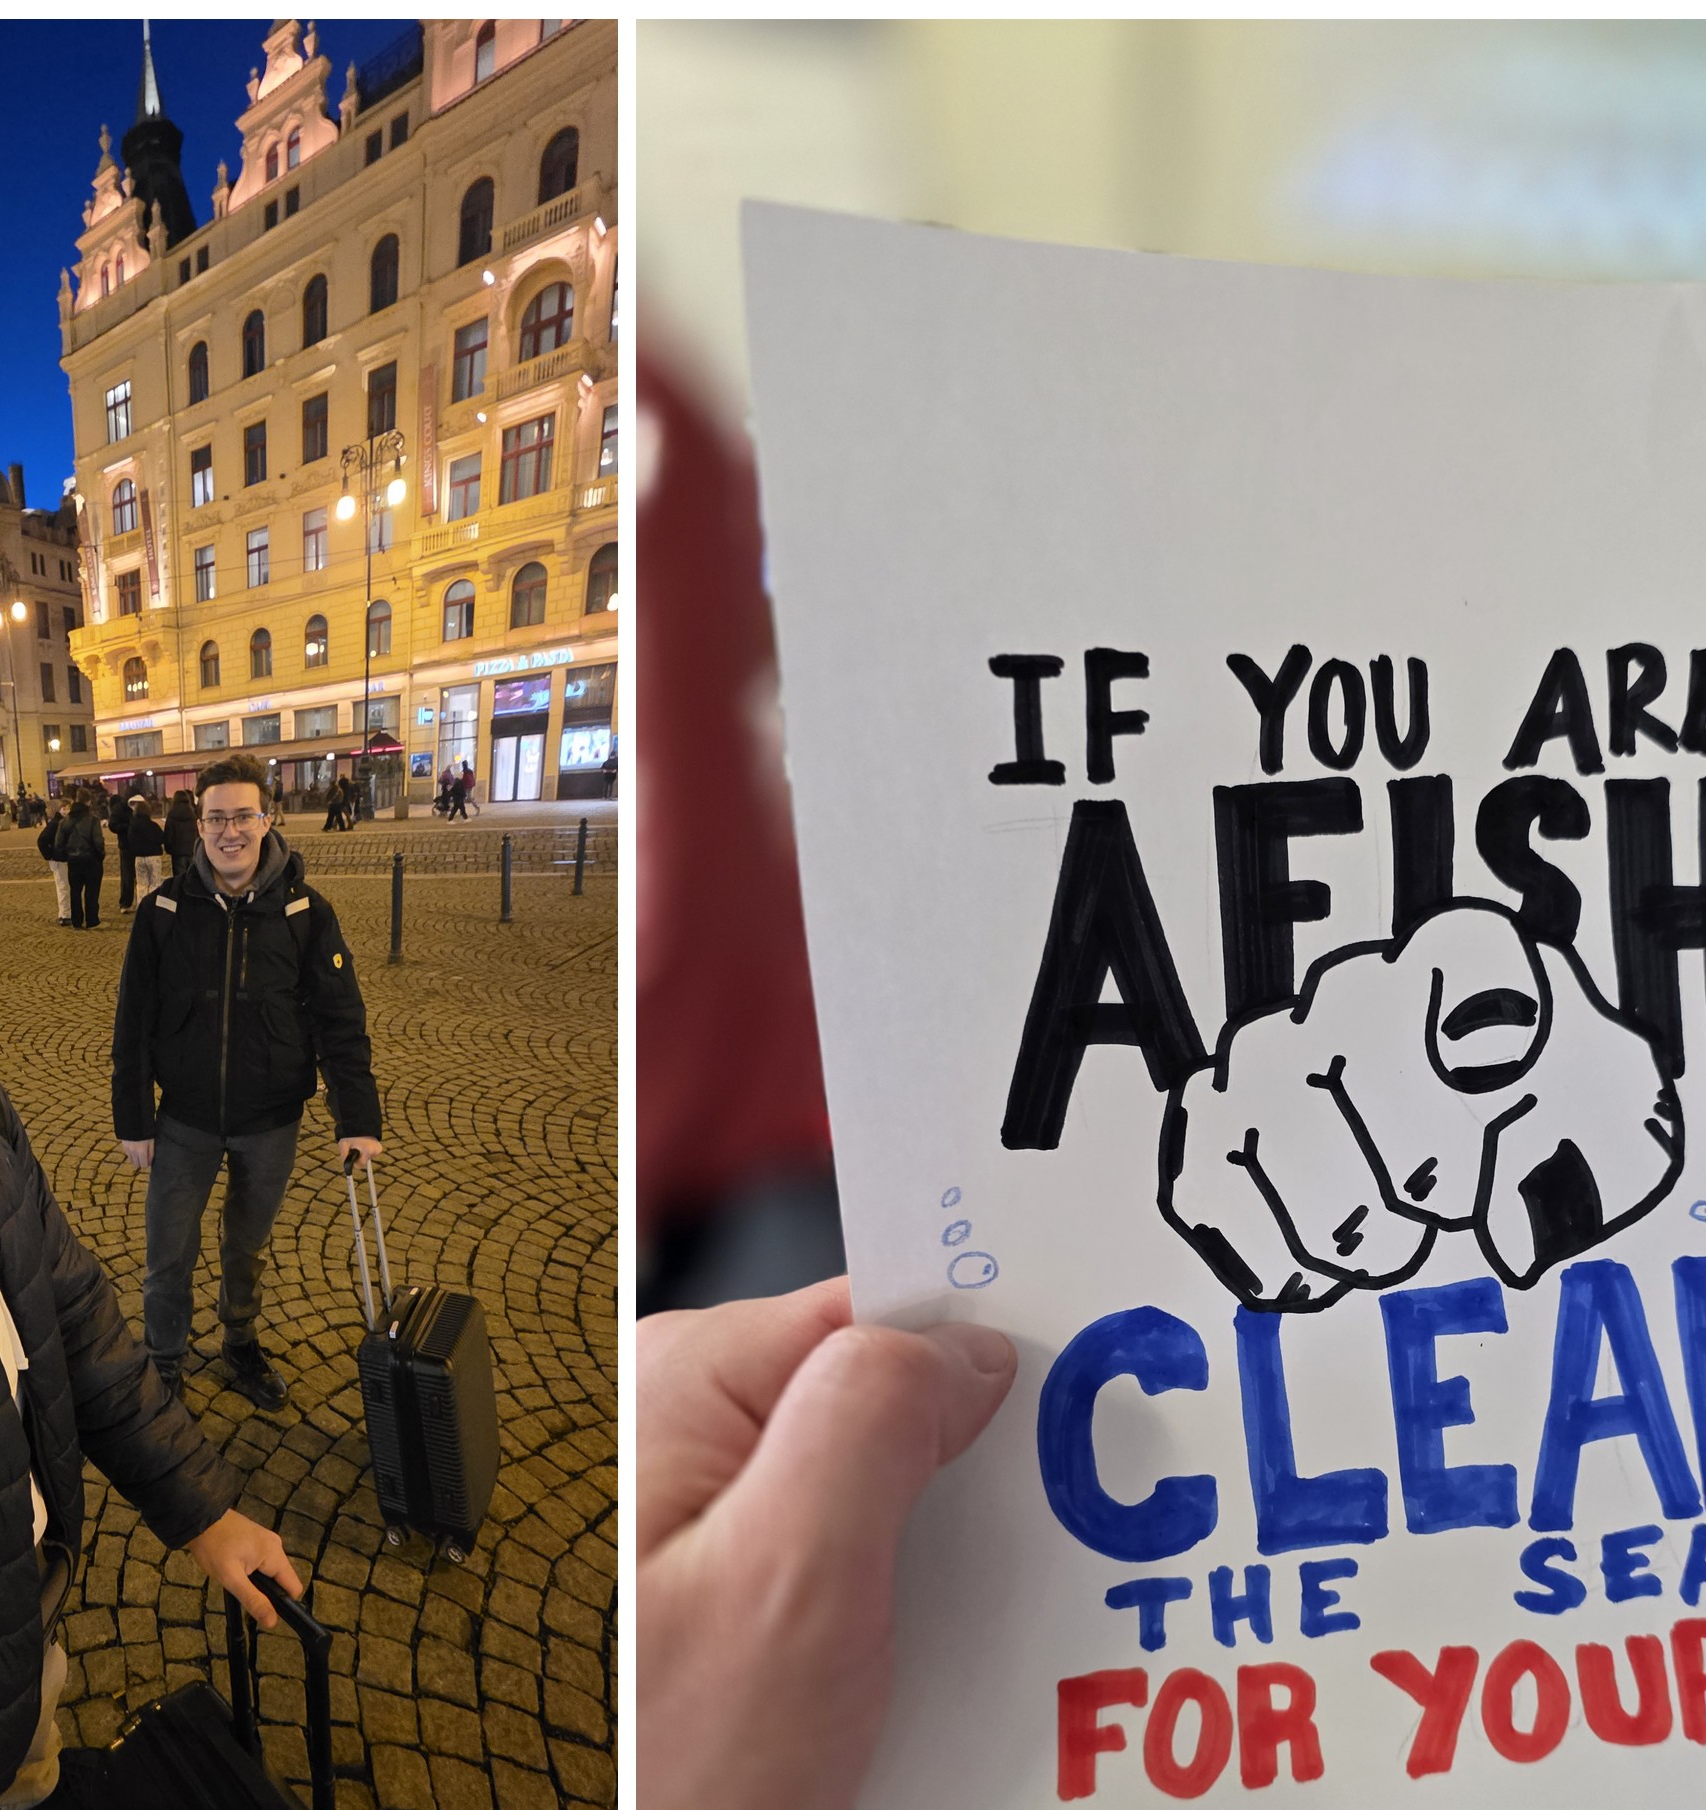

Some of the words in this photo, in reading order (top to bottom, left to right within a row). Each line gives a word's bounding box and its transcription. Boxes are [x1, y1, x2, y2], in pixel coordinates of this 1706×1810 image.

[474, 659, 514, 677] PIZZA
[517, 656, 529, 670] &
[531, 648, 575, 668] PASTA
[988, 647, 1150, 785] IF
[1226, 644, 1430, 778] YOU
[1105, 1556, 1361, 1653] THE
[1055, 1662, 1324, 1803] FOR
